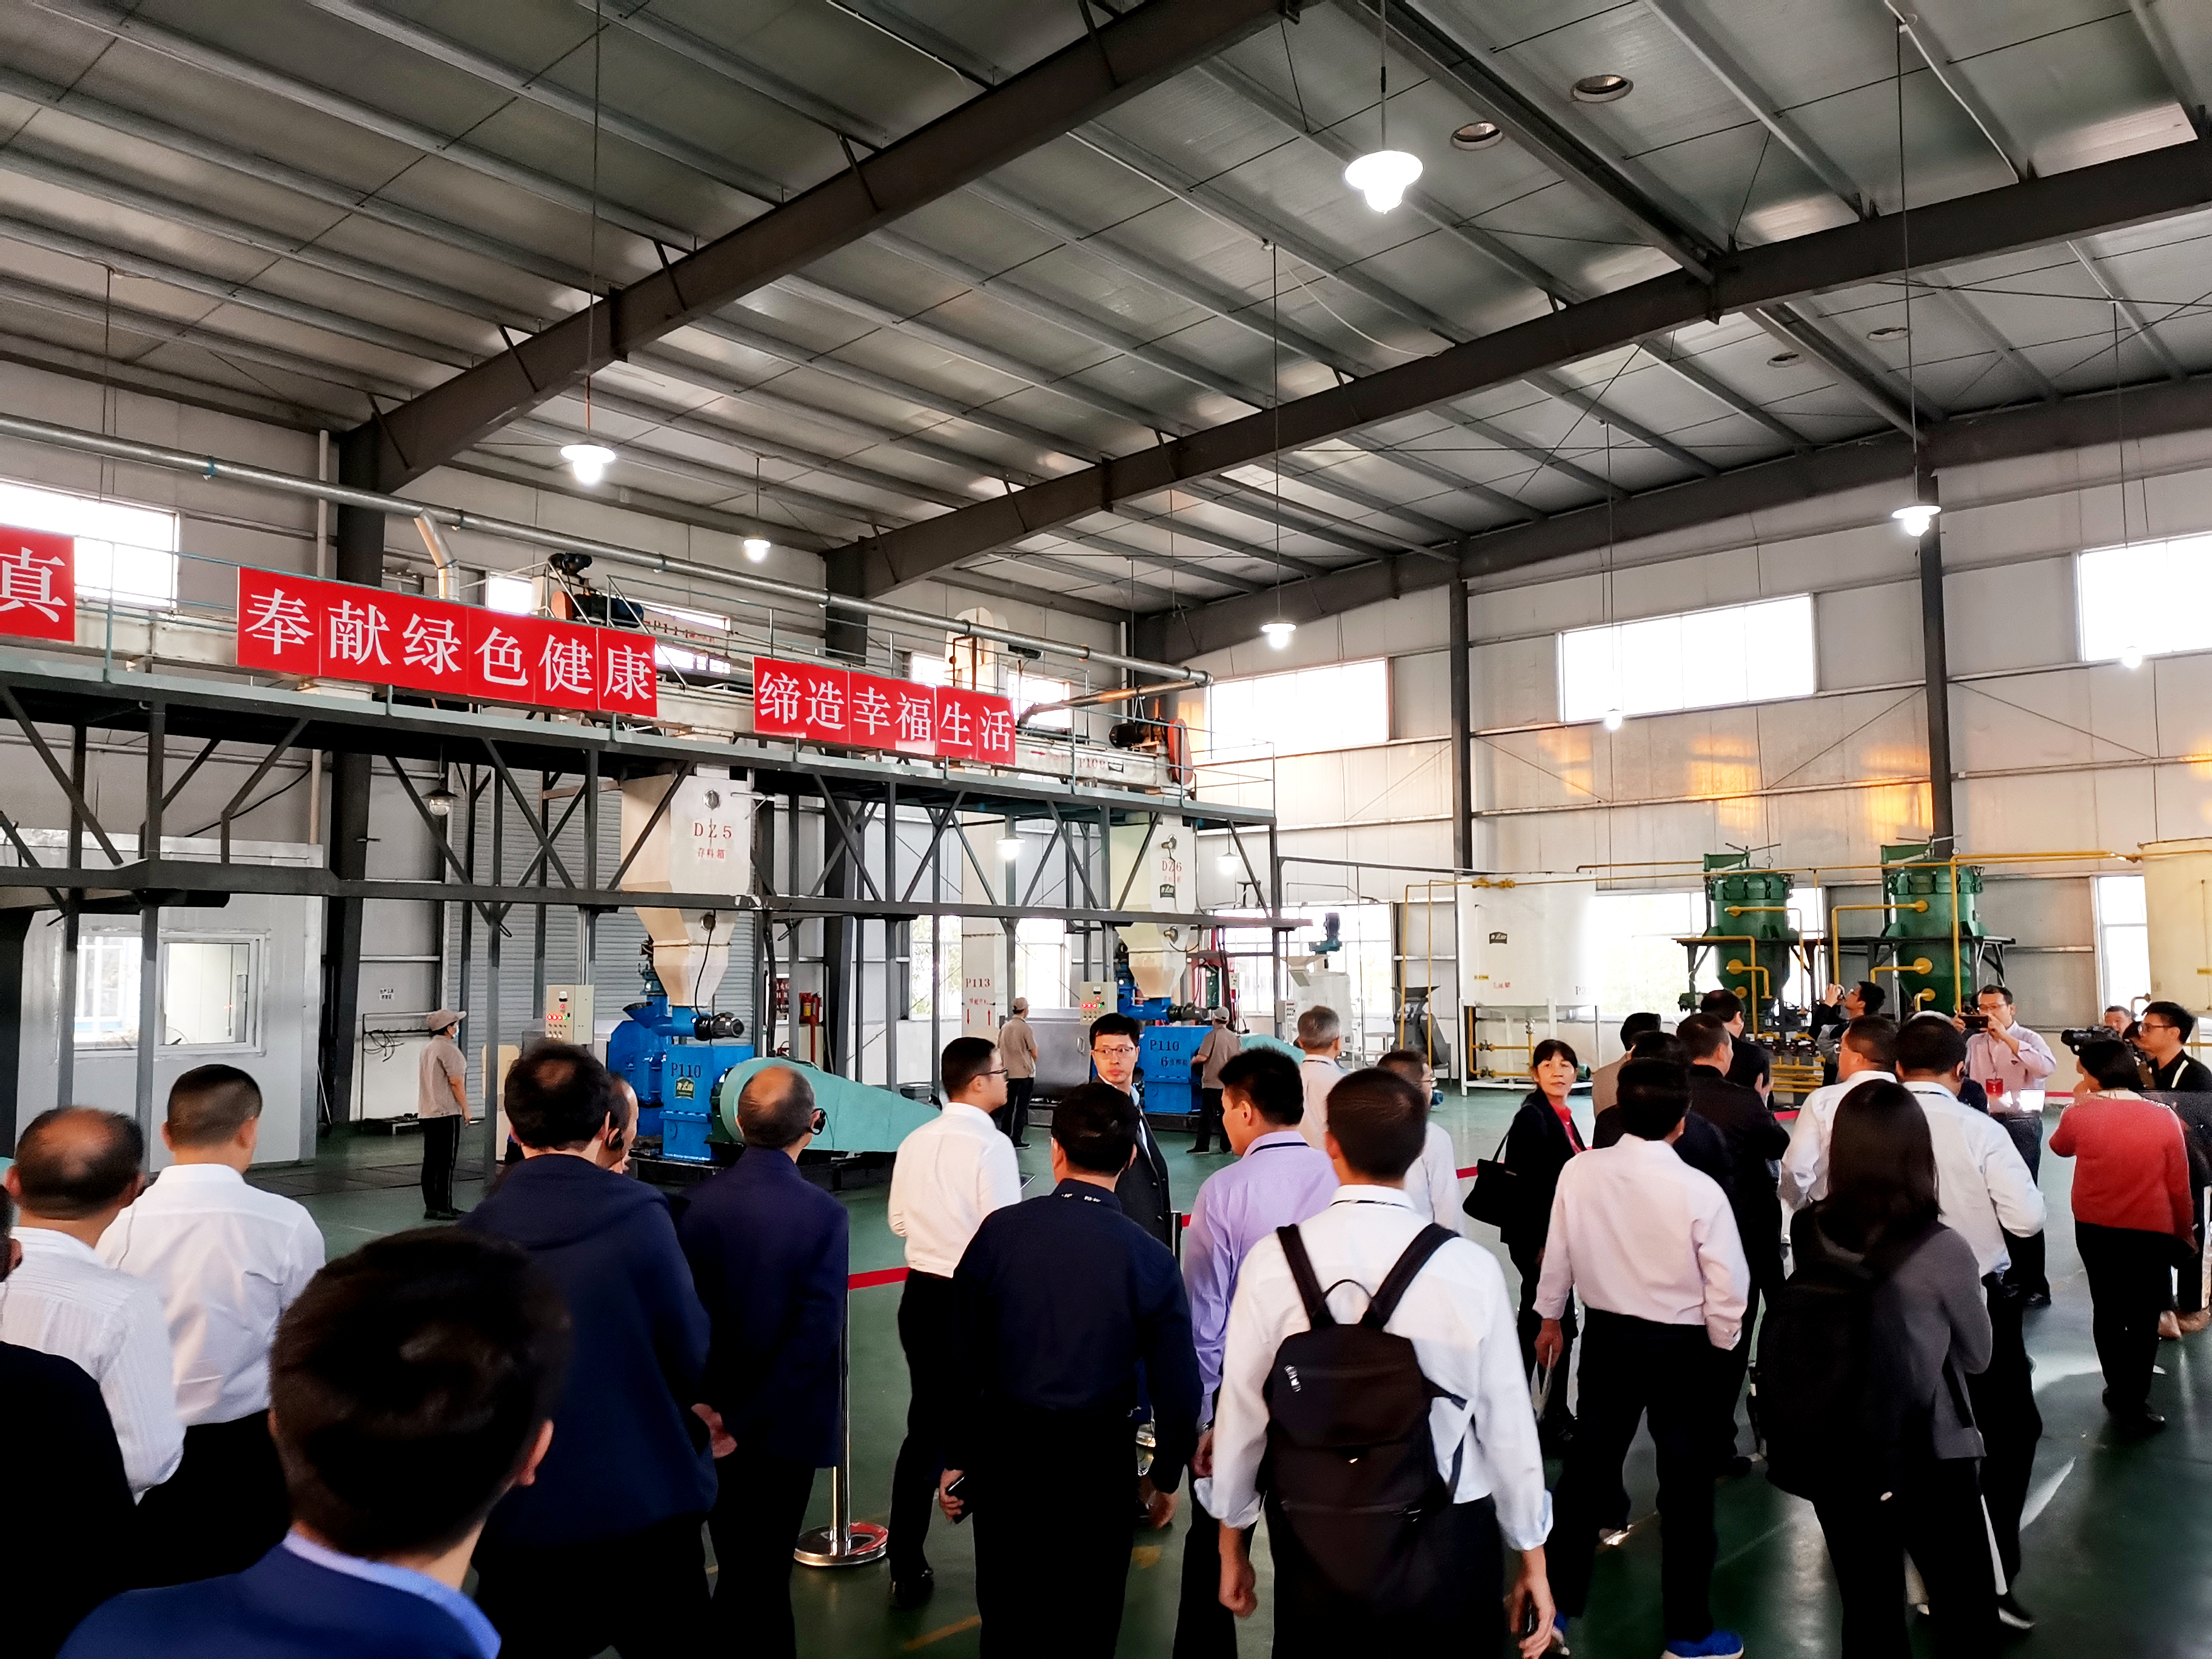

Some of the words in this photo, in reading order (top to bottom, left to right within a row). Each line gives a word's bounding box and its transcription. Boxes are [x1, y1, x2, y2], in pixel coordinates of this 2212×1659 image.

[0, 546, 67, 622] 真
[245, 588, 652, 700] 奉献绿色健康
[759, 671, 1016, 751] 缔造幸福生活
[694, 822, 732, 839] DZ5
[965, 978, 990, 988] P113
[1150, 1039, 1180, 1051] P110
[671, 1062, 702, 1079] P110
